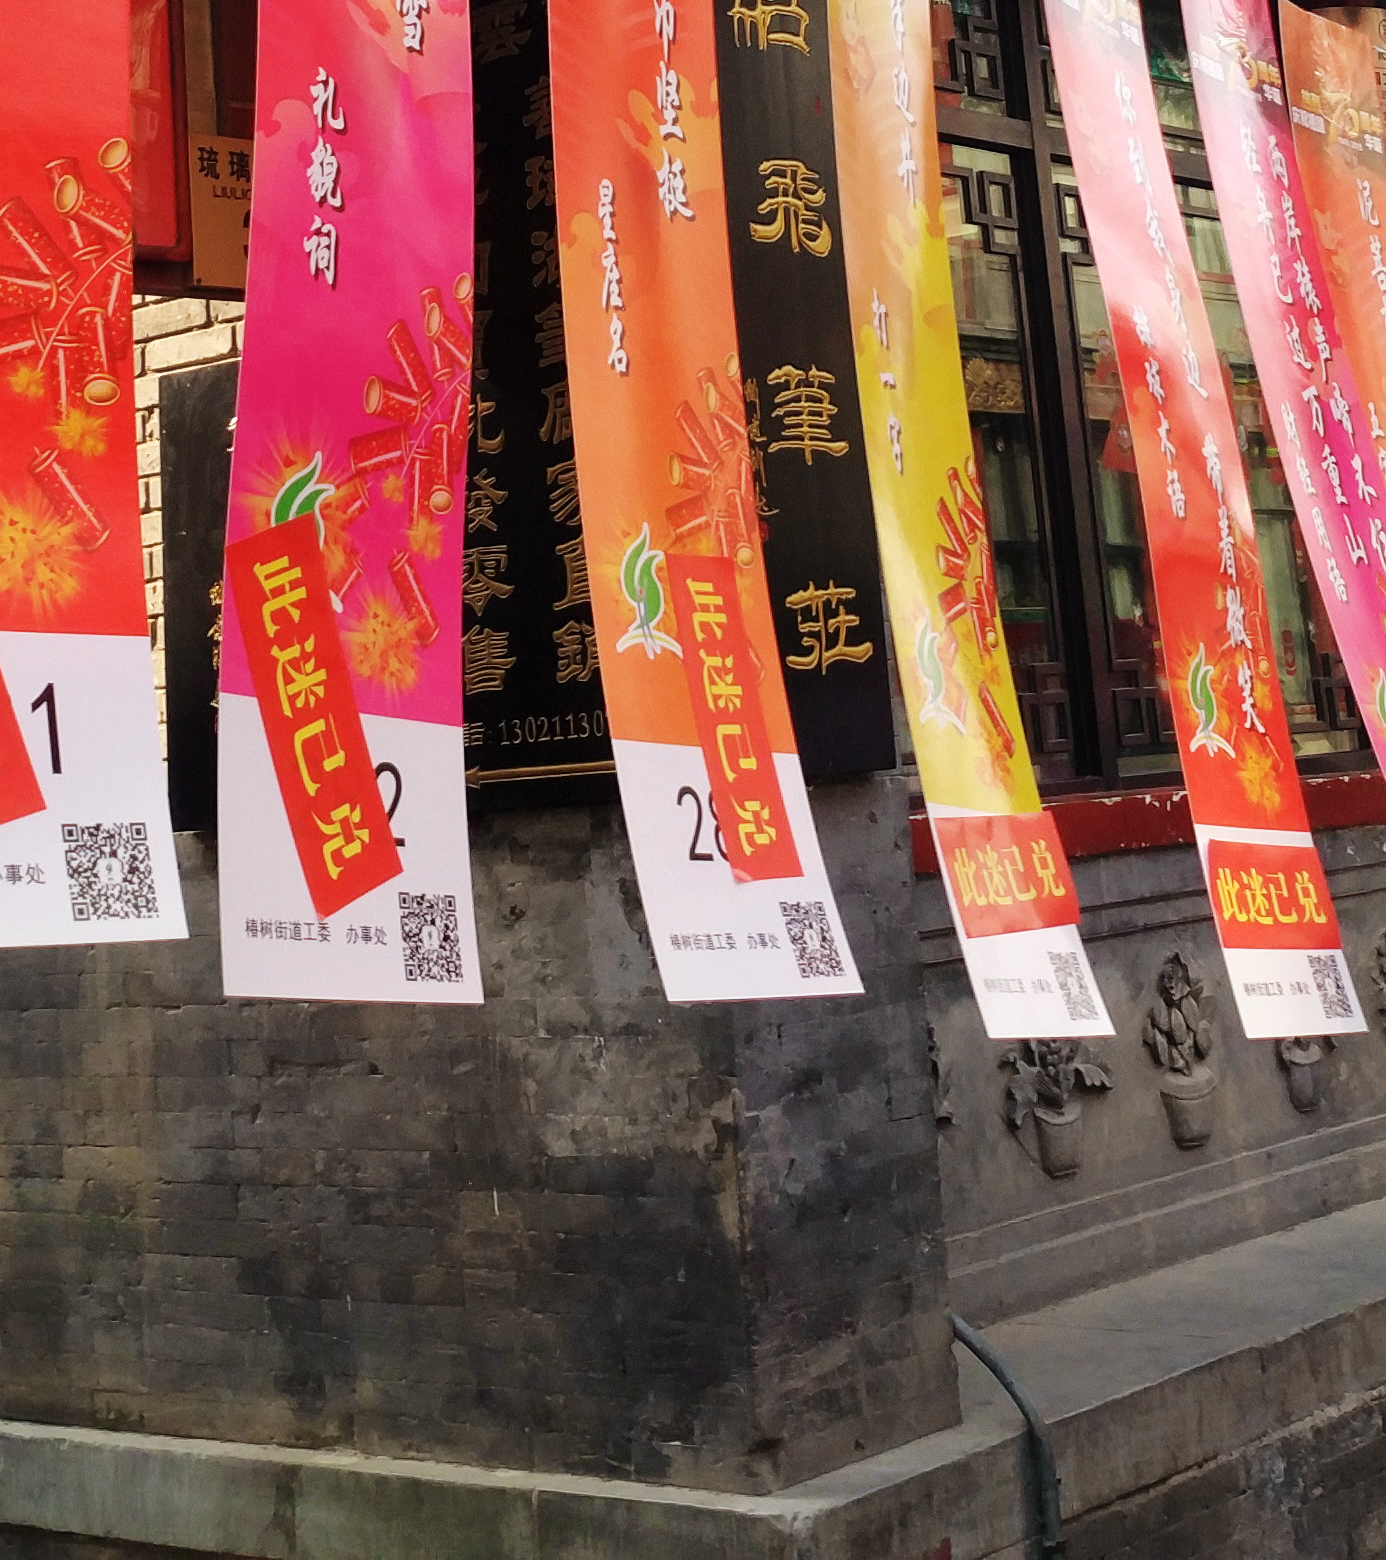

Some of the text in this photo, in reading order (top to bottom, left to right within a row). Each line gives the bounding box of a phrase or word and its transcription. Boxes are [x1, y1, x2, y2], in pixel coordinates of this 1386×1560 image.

[302, 66, 346, 289] 礼貌词
[253, 556, 370, 881] 此迷已兑
[685, 577, 779, 858] 此迷已兑
[245, 917, 388, 946] 椿树街道工委 办事处
[953, 839, 1066, 907] 此迷已兑
[1215, 867, 1328, 926] 此迷已兑
